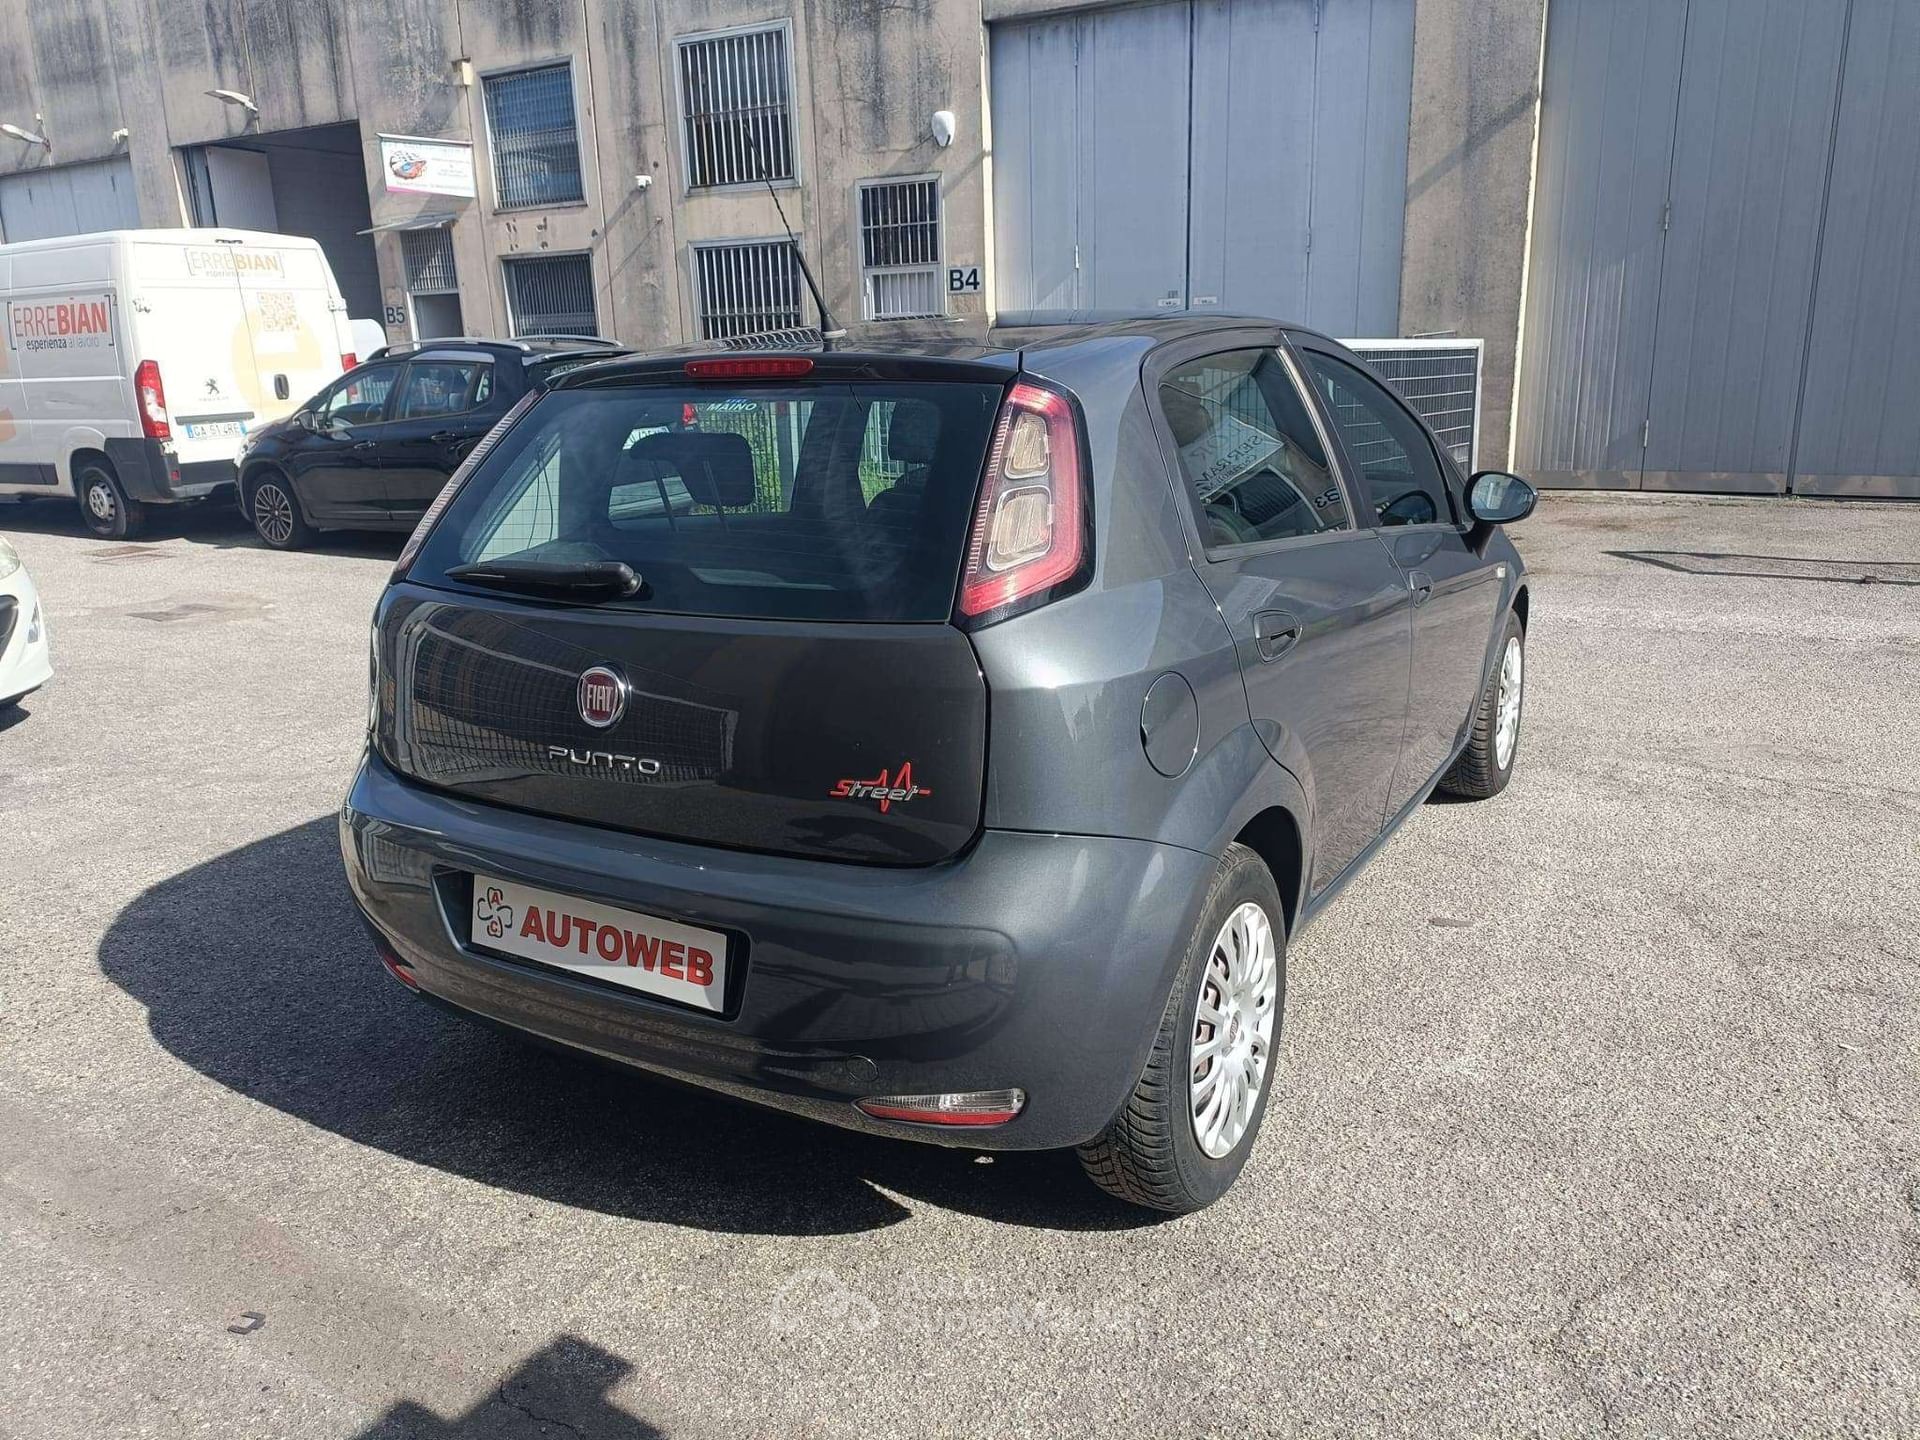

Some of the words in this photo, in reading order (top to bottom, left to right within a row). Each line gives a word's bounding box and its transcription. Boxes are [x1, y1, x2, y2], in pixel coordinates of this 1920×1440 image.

[190, 251, 278, 271] ERREBIAN
[949, 268, 980, 291] B4
[13, 302, 107, 338] ERREBIAN
[386, 306, 405, 324] B5
[26, 338, 67, 352] esperienza
[587, 683, 614, 712] FIAT
[549, 745, 660, 774] PUNTO
[519, 906, 714, 987] AUTOWEB
